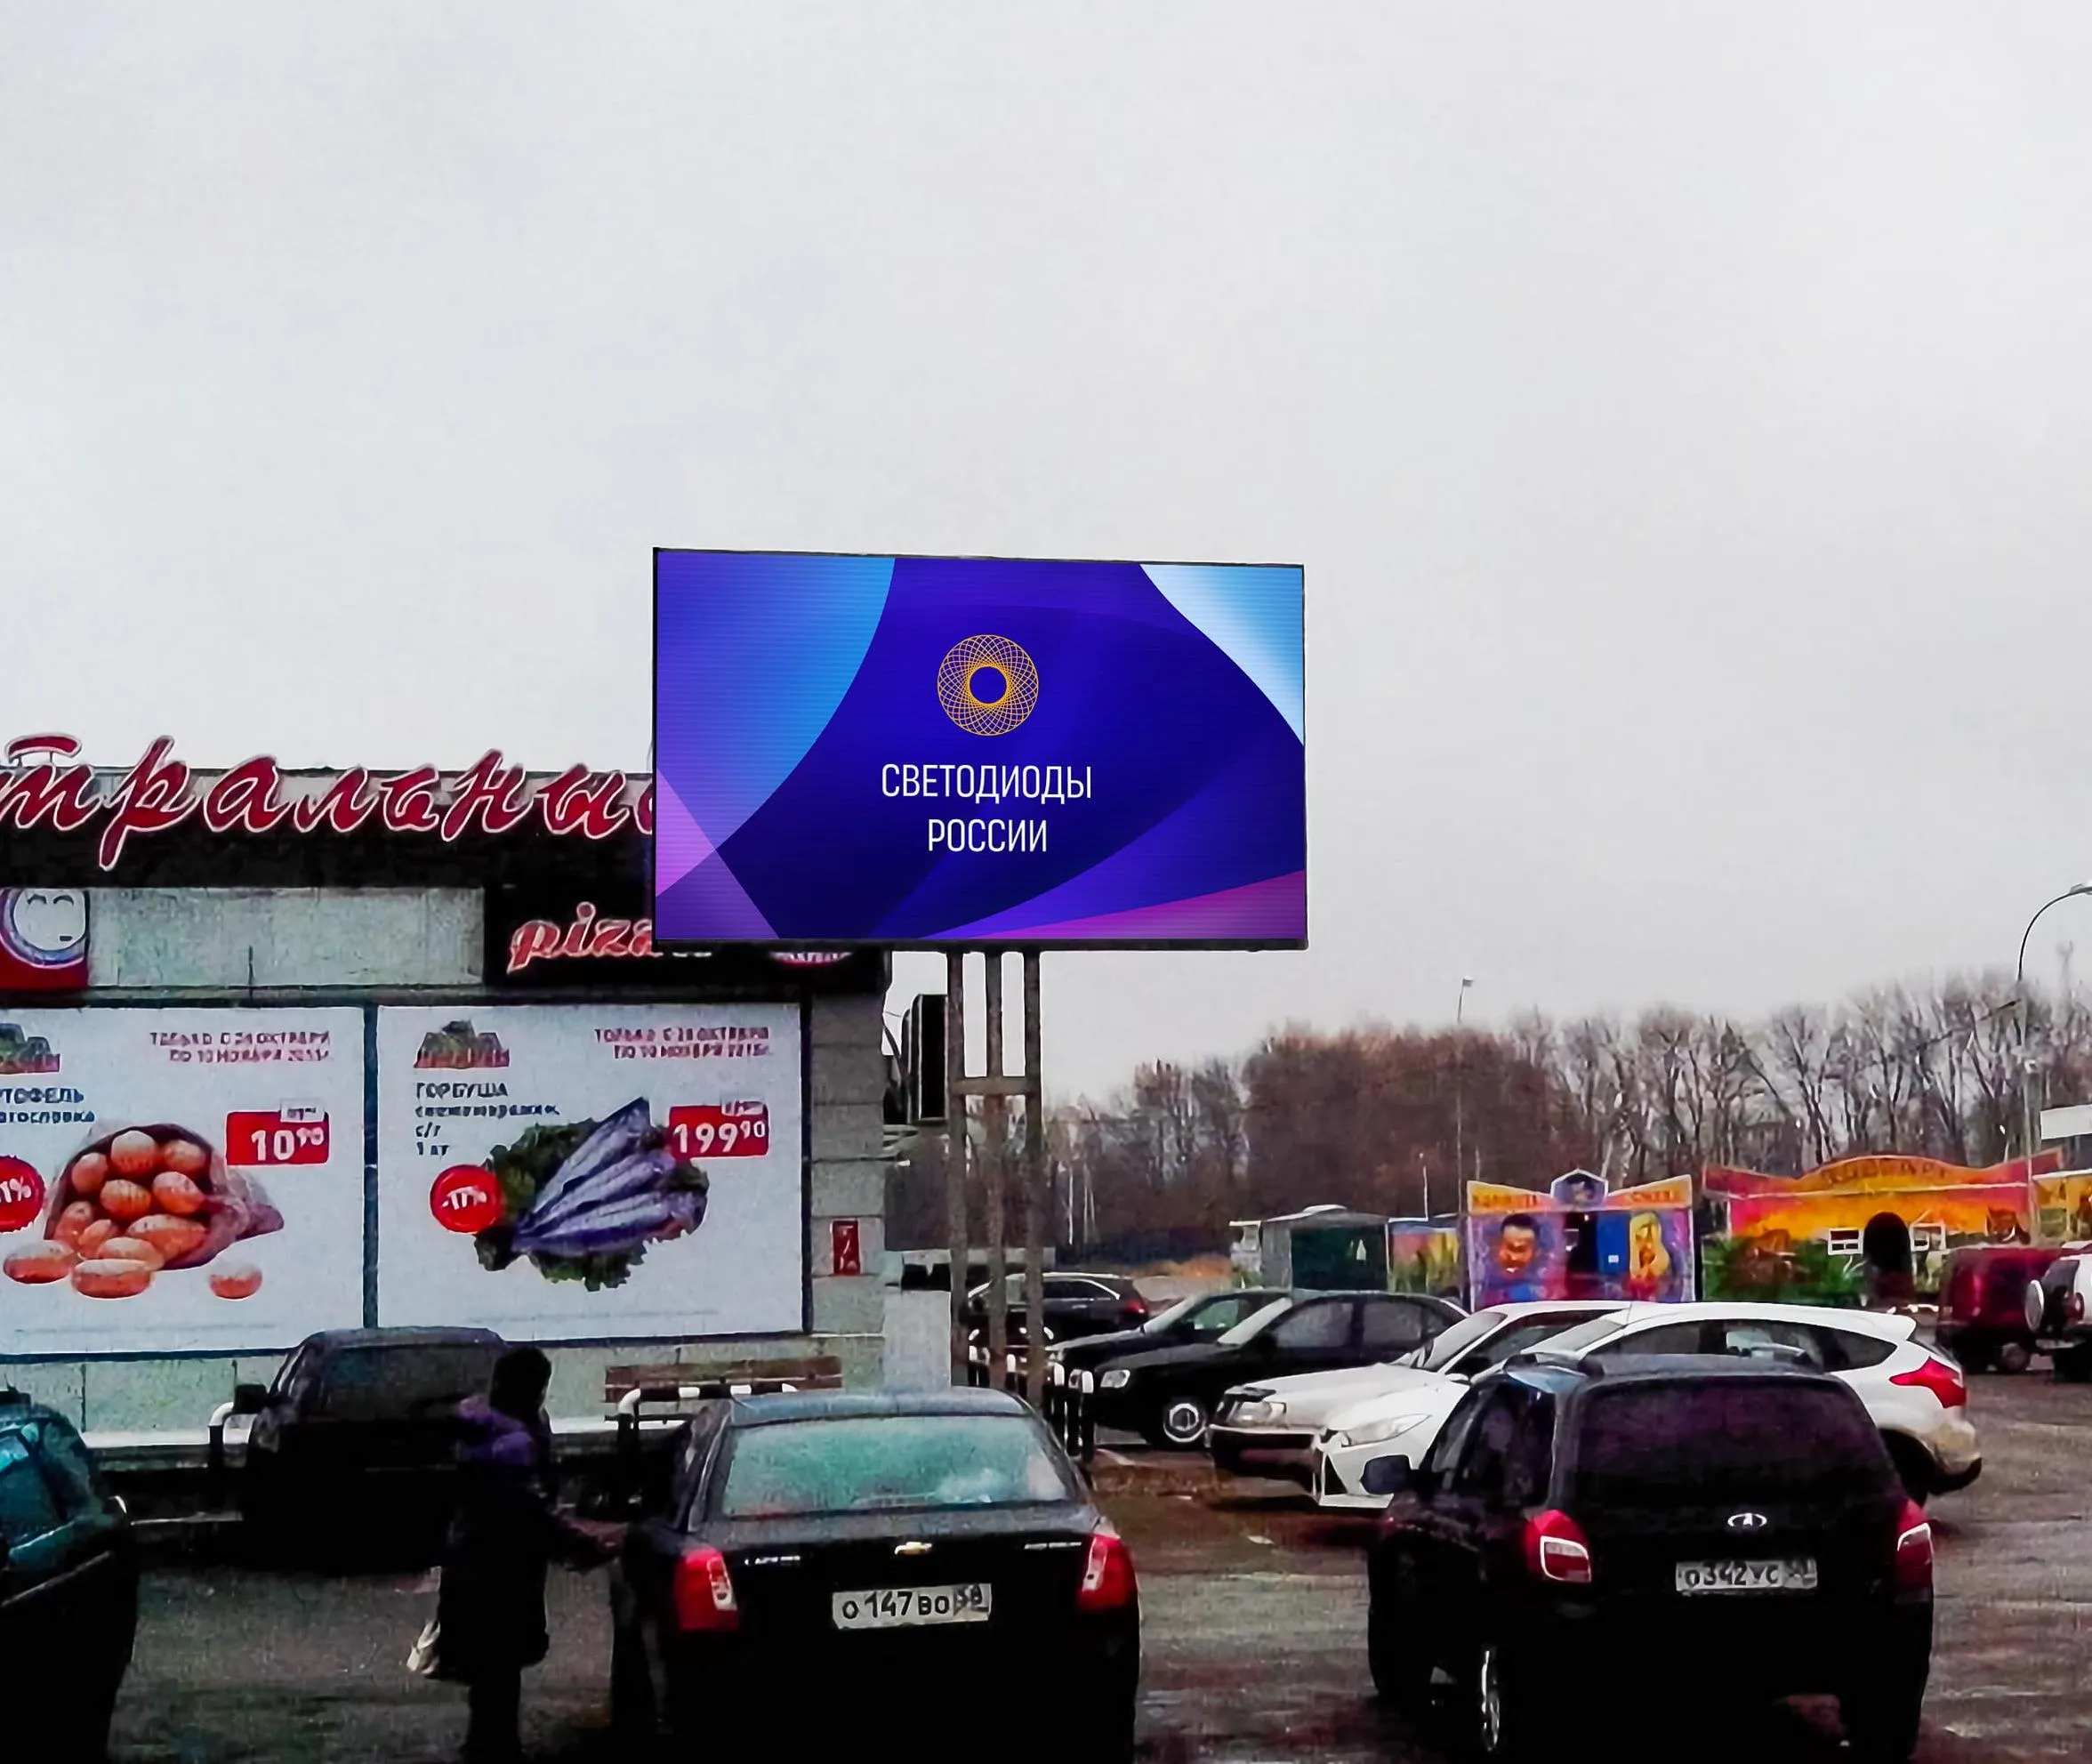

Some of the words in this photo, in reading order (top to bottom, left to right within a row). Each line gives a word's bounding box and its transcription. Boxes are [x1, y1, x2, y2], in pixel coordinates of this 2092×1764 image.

[881, 763, 1091, 804] СВЕТОДИОДЫ
[929, 818, 1047, 852] РОССИИ
[416, 1083, 508, 1099] ГОРБУША
[251, 1129, 295, 1162] 10
[0, 1176, 32, 1203] 1%
